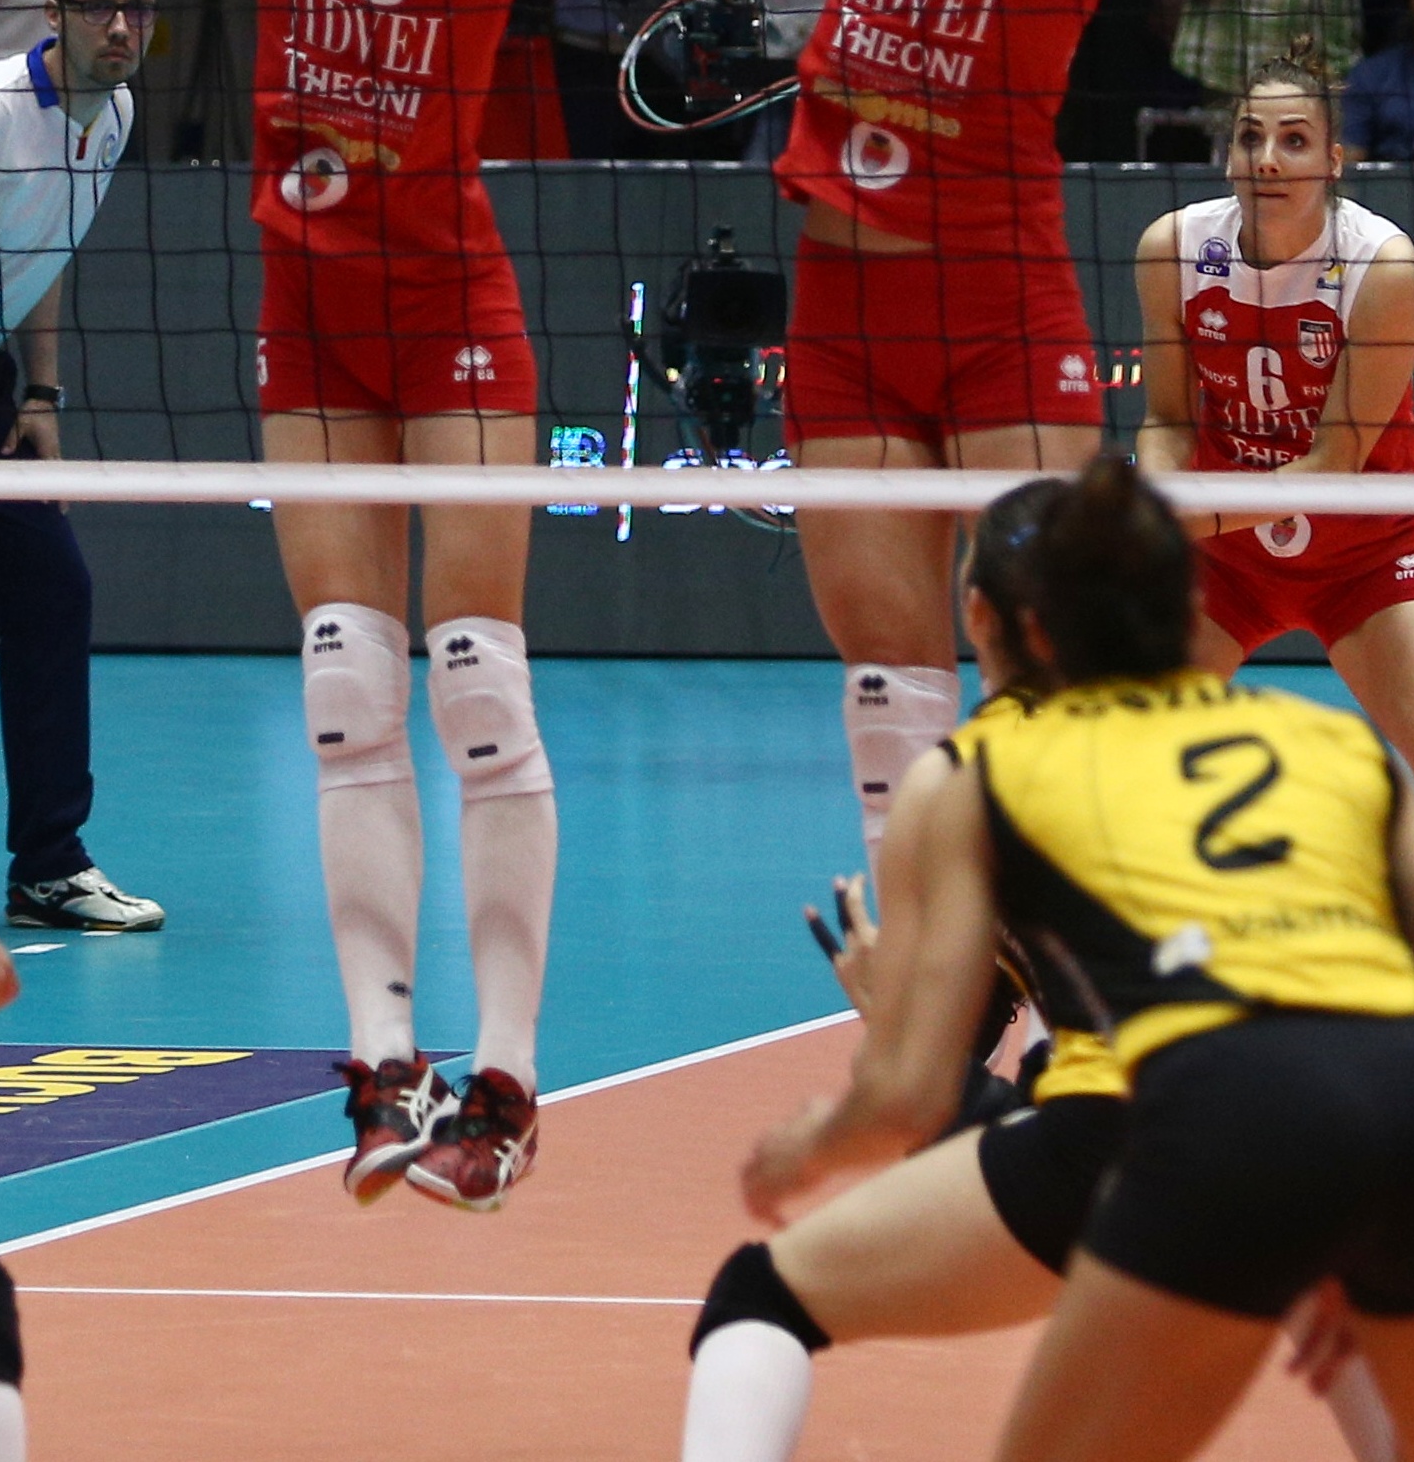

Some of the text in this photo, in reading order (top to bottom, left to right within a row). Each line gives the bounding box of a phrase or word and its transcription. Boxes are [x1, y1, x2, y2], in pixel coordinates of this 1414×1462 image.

[283, 47, 423, 119] THEONI
[453, 368, 496, 382] erea
[1246, 345, 1291, 412] 6
[1178, 731, 1294, 874] 2
